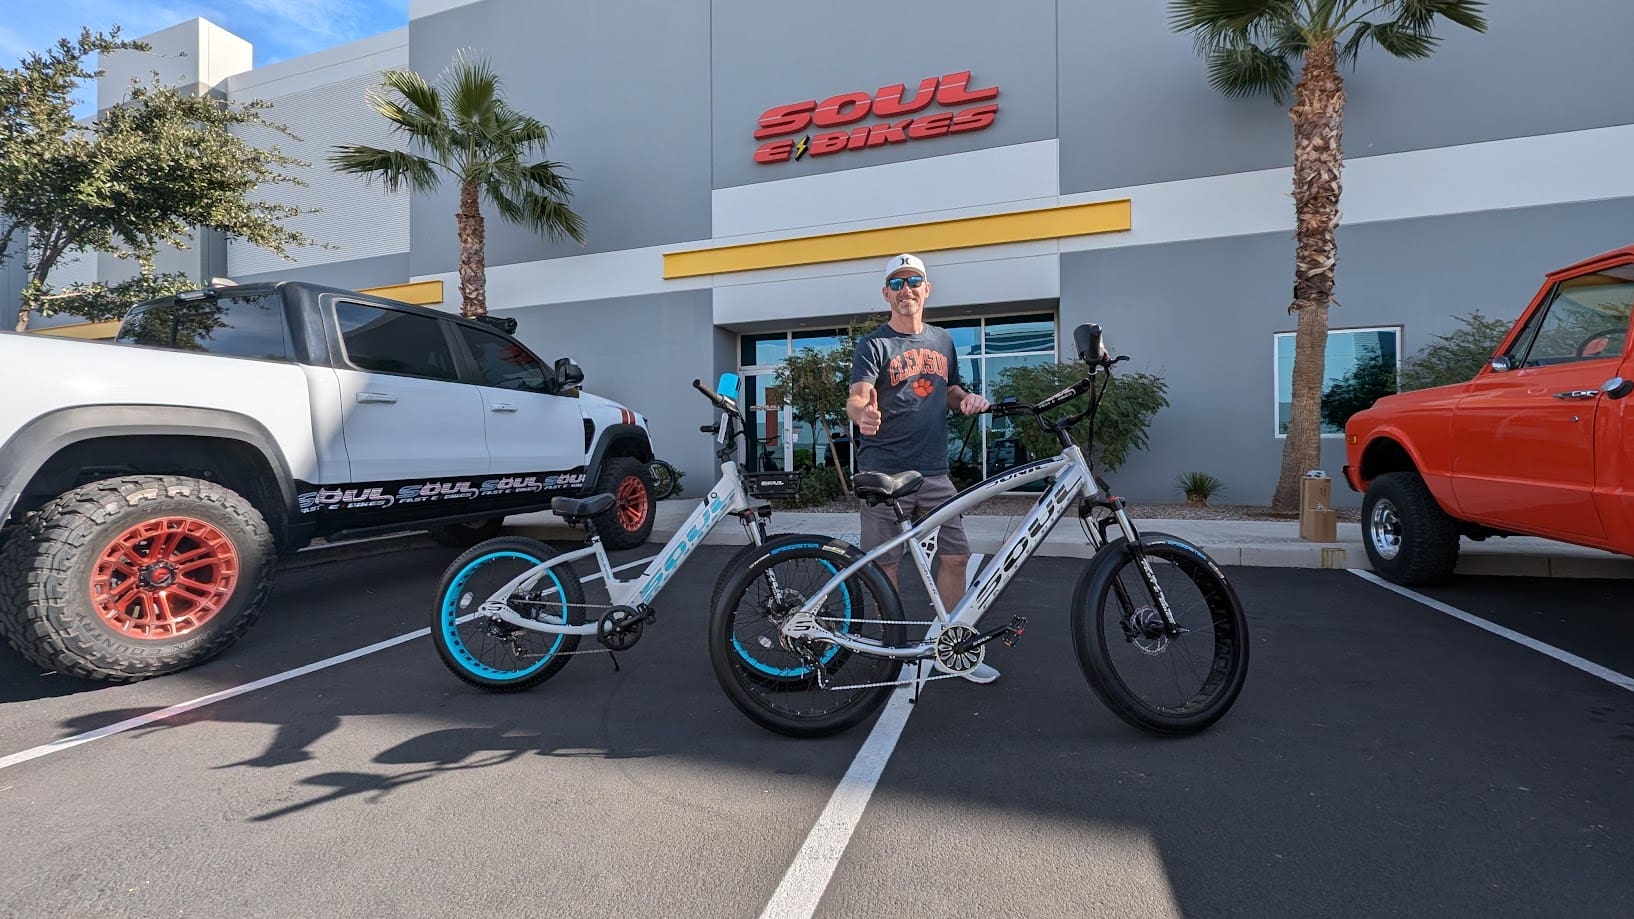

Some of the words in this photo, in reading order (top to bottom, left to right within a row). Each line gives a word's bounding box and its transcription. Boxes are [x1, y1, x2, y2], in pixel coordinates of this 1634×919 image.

[753, 70, 1000, 140] SOUL
[754, 139, 794, 165] E
[808, 103, 999, 157] BIKES
[889, 347, 949, 387] CLEMSON
[297, 487, 395, 509] SOUL
[395, 481, 480, 500] SOUL
[480, 476, 543, 493] SOUL
[639, 487, 736, 605] SOUL
[976, 475, 1083, 610] SOUL
